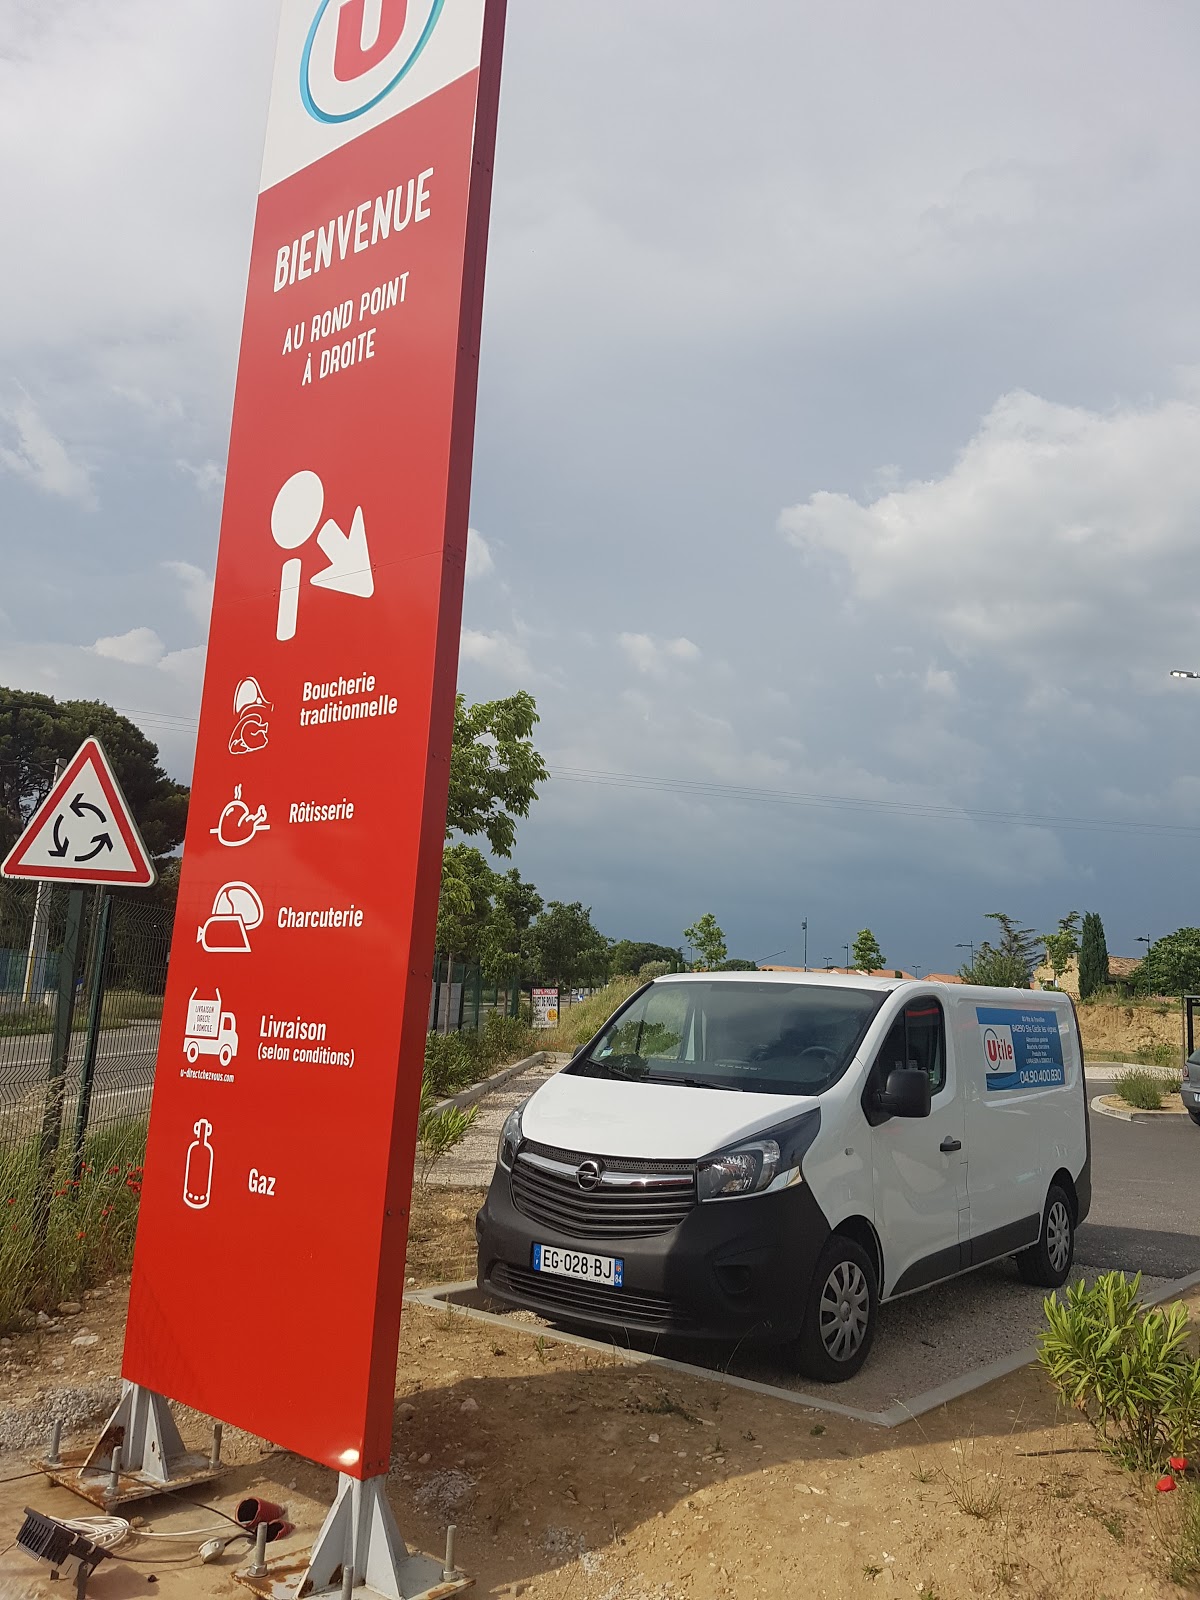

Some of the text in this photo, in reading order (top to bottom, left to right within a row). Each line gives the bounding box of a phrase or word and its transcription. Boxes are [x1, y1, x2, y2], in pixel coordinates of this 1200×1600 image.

[333, 0, 407, 83] U
[273, 167, 434, 293] BIENVENUE
[282, 271, 409, 355] AU ROND POINT
[319, 328, 377, 379] DROITE
[302, 671, 376, 702] Boucherie
[300, 695, 398, 726] traditionnelle
[289, 798, 355, 823] Rôtisserie
[277, 905, 363, 928] Charcuterie
[259, 1014, 327, 1041] Livraison
[257, 1042, 355, 1068] (selon conditions)
[987, 1039, 1012, 1061] Utile
[248, 1168, 276, 1196] Gaz
[543, 1249, 611, 1278] EG-028-BJ
[614, 1273, 622, 1284] 84
